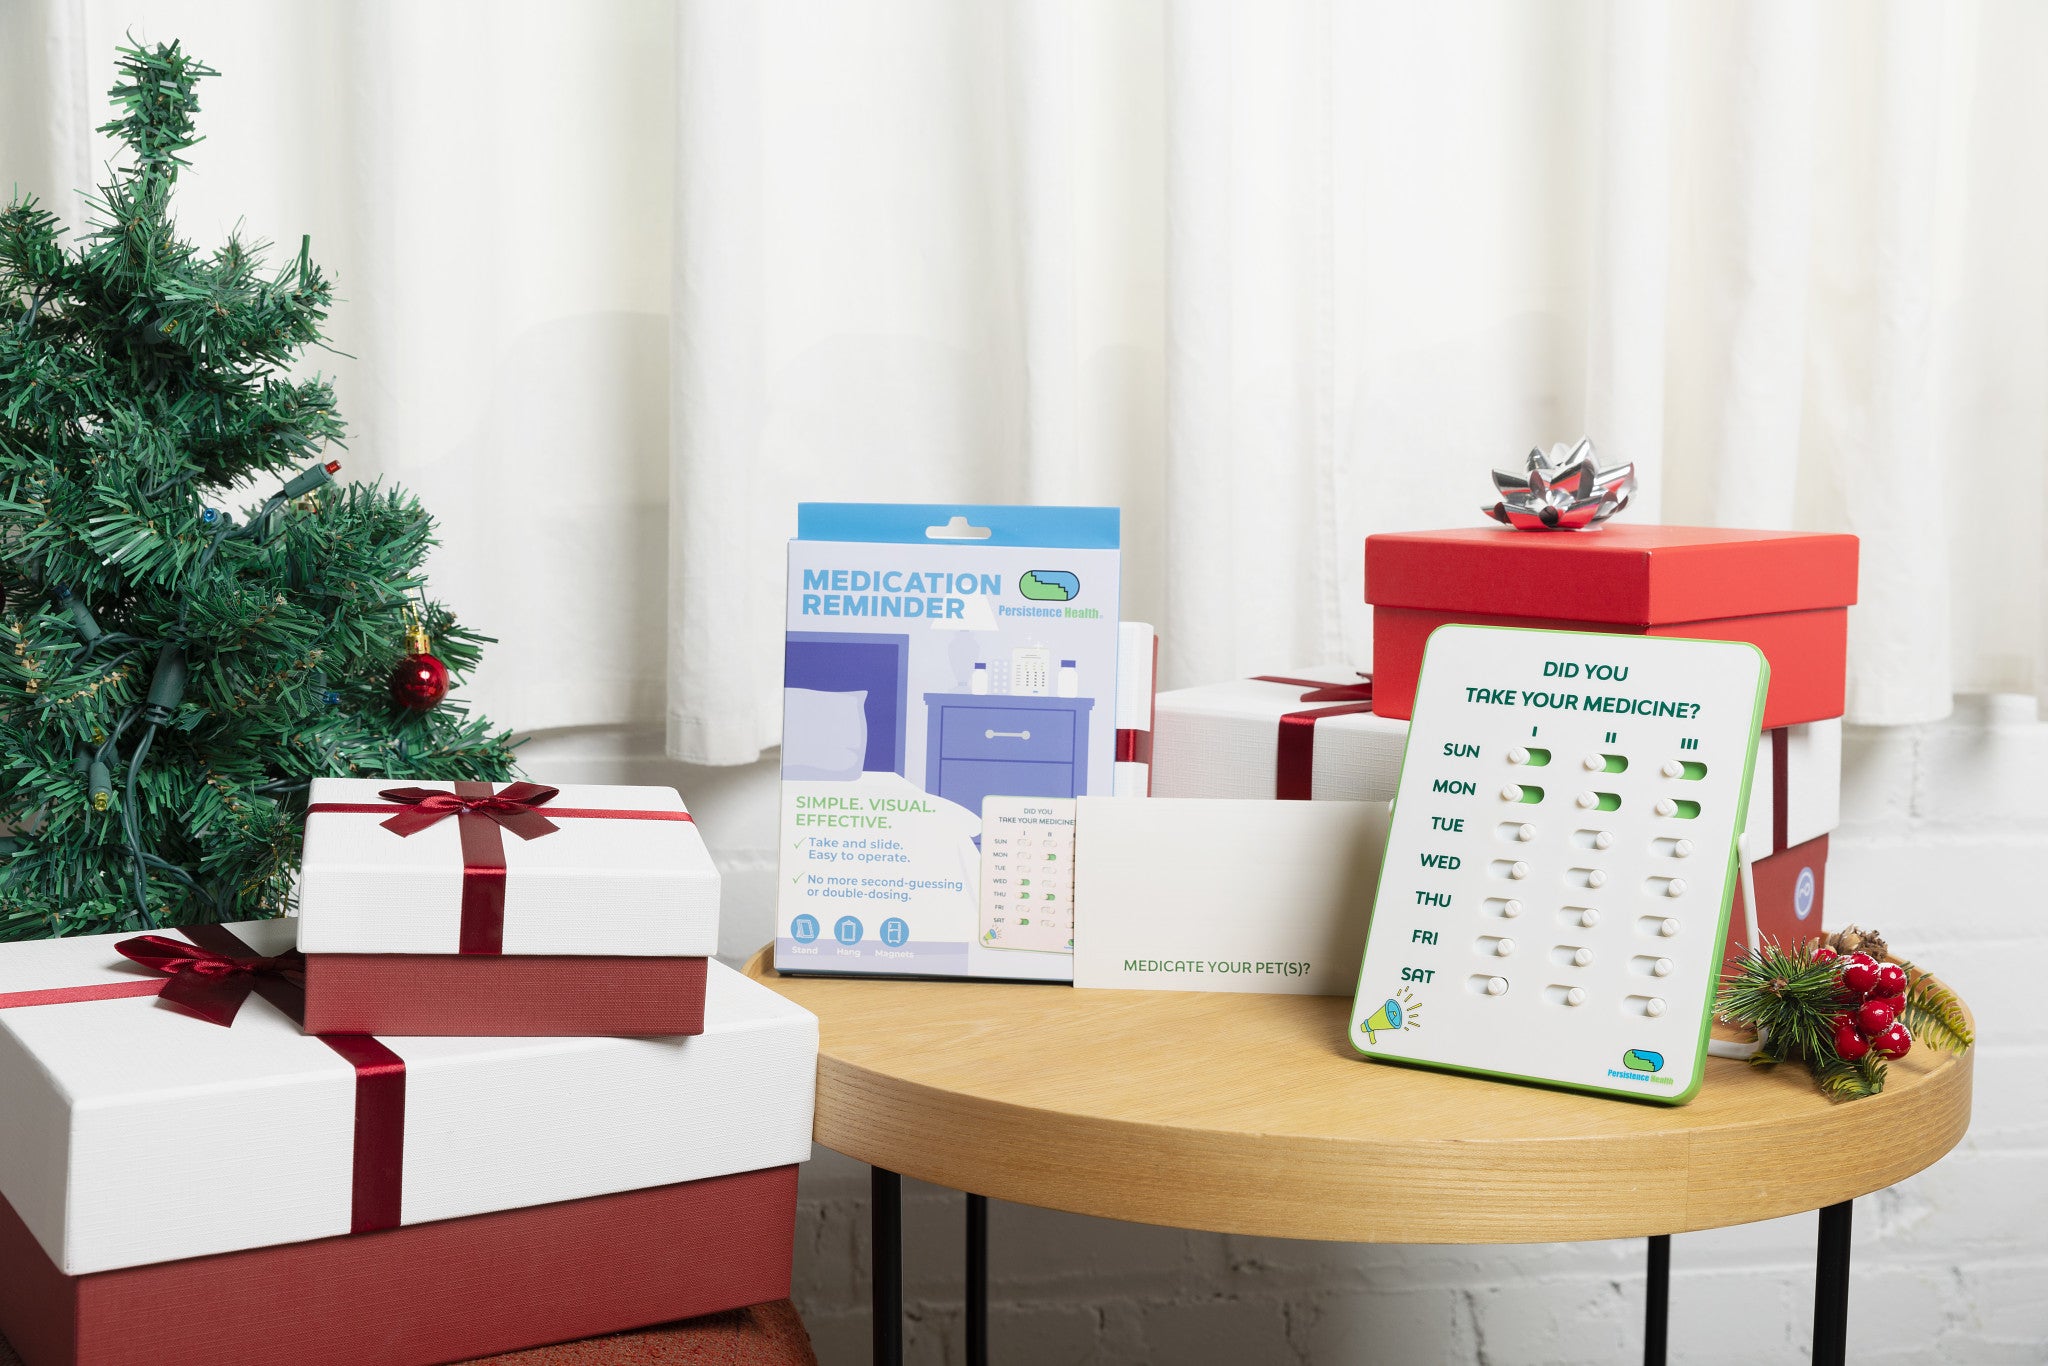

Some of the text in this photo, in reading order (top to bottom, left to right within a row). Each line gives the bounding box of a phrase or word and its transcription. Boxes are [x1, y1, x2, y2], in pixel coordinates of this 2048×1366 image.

[803, 569, 1001, 595] MEDICATION
[802, 594, 965, 619] REMINDER
[998, 605, 1062, 617] Persistence
[1543, 661, 1628, 682] DID YOU
[1466, 687, 1700, 720] TAKE YOUR MEDICINE?
[1443, 743, 1480, 758] SUN
[1680, 738, 1698, 750] III
[1432, 779, 1476, 796] MON
[796, 796, 936, 813] SIMPLE. VISUAL.
[796, 814, 892, 829] EFFECTIVE.
[1432, 816, 1464, 832] TUE
[809, 837, 903, 850] Take and slide.
[809, 850, 910, 863] Easy to operate.
[1420, 853, 1461, 870] WED
[808, 875, 962, 891] No more second-guessing
[807, 887, 911, 902] or double-dosing.
[1415, 891, 1452, 908] THU
[1412, 930, 1438, 945] FRI
[792, 946, 914, 959] Stand Hang Magnets
[1124, 959, 1310, 976] MEDICATE YOUR PET(S)?
[1401, 967, 1435, 984] SAT
[1608, 1069, 1673, 1085] Persistence Health
